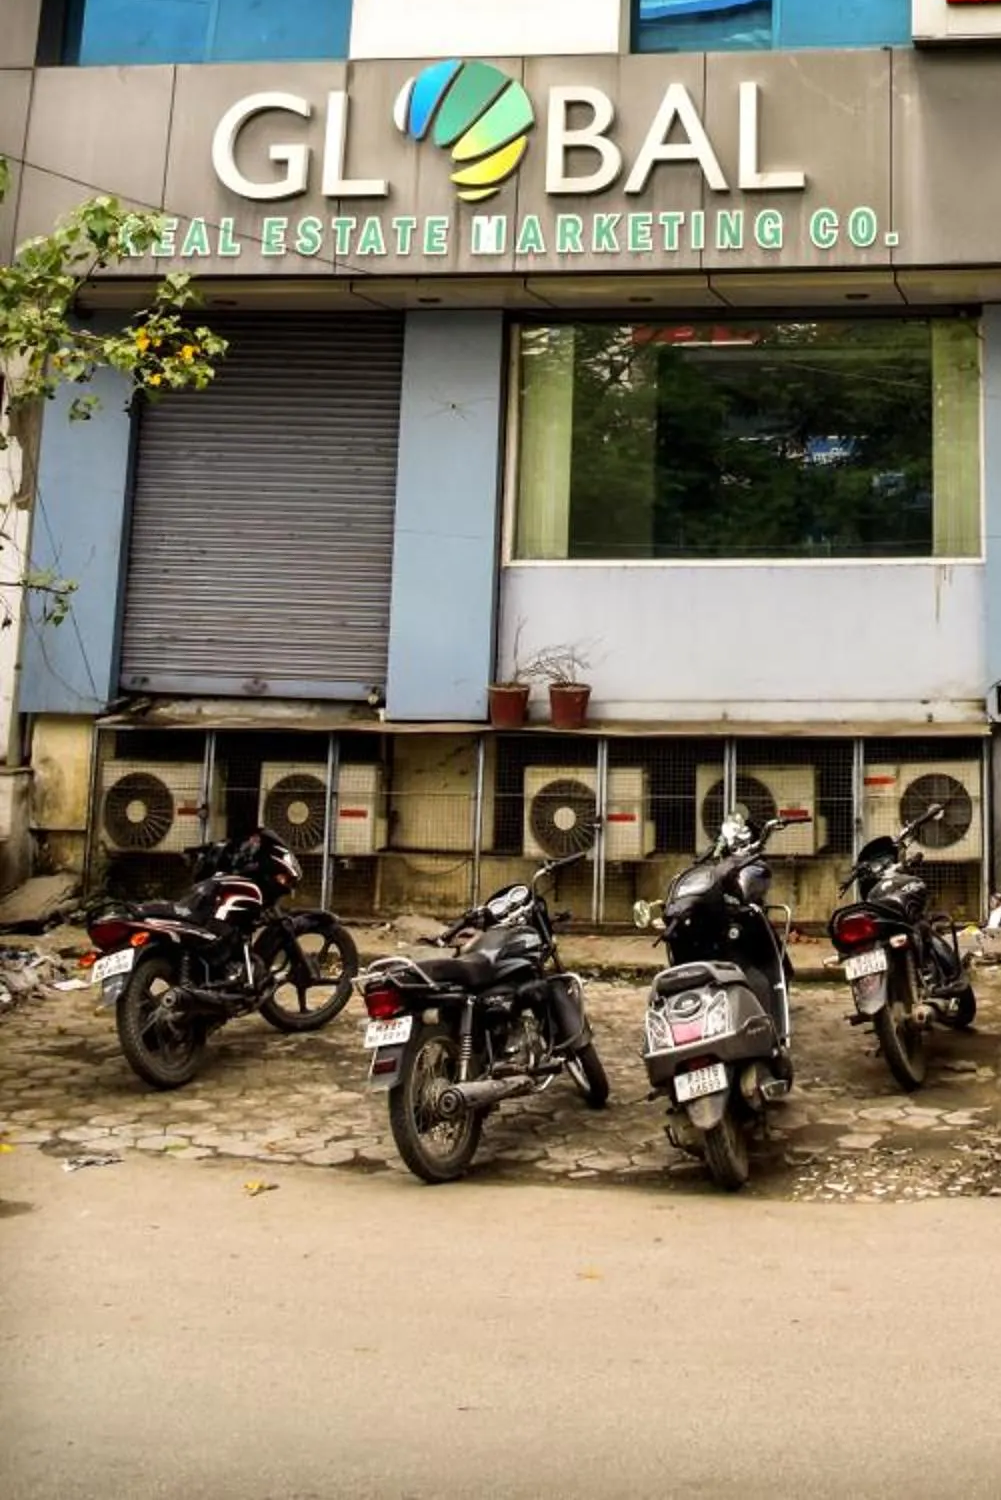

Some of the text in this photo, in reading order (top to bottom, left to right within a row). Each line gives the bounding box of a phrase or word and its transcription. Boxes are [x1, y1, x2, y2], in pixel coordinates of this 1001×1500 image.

[261, 215, 450, 258] ESTATE
[470, 208, 784, 255] MARKETING
[809, 206, 900, 250] CO.
